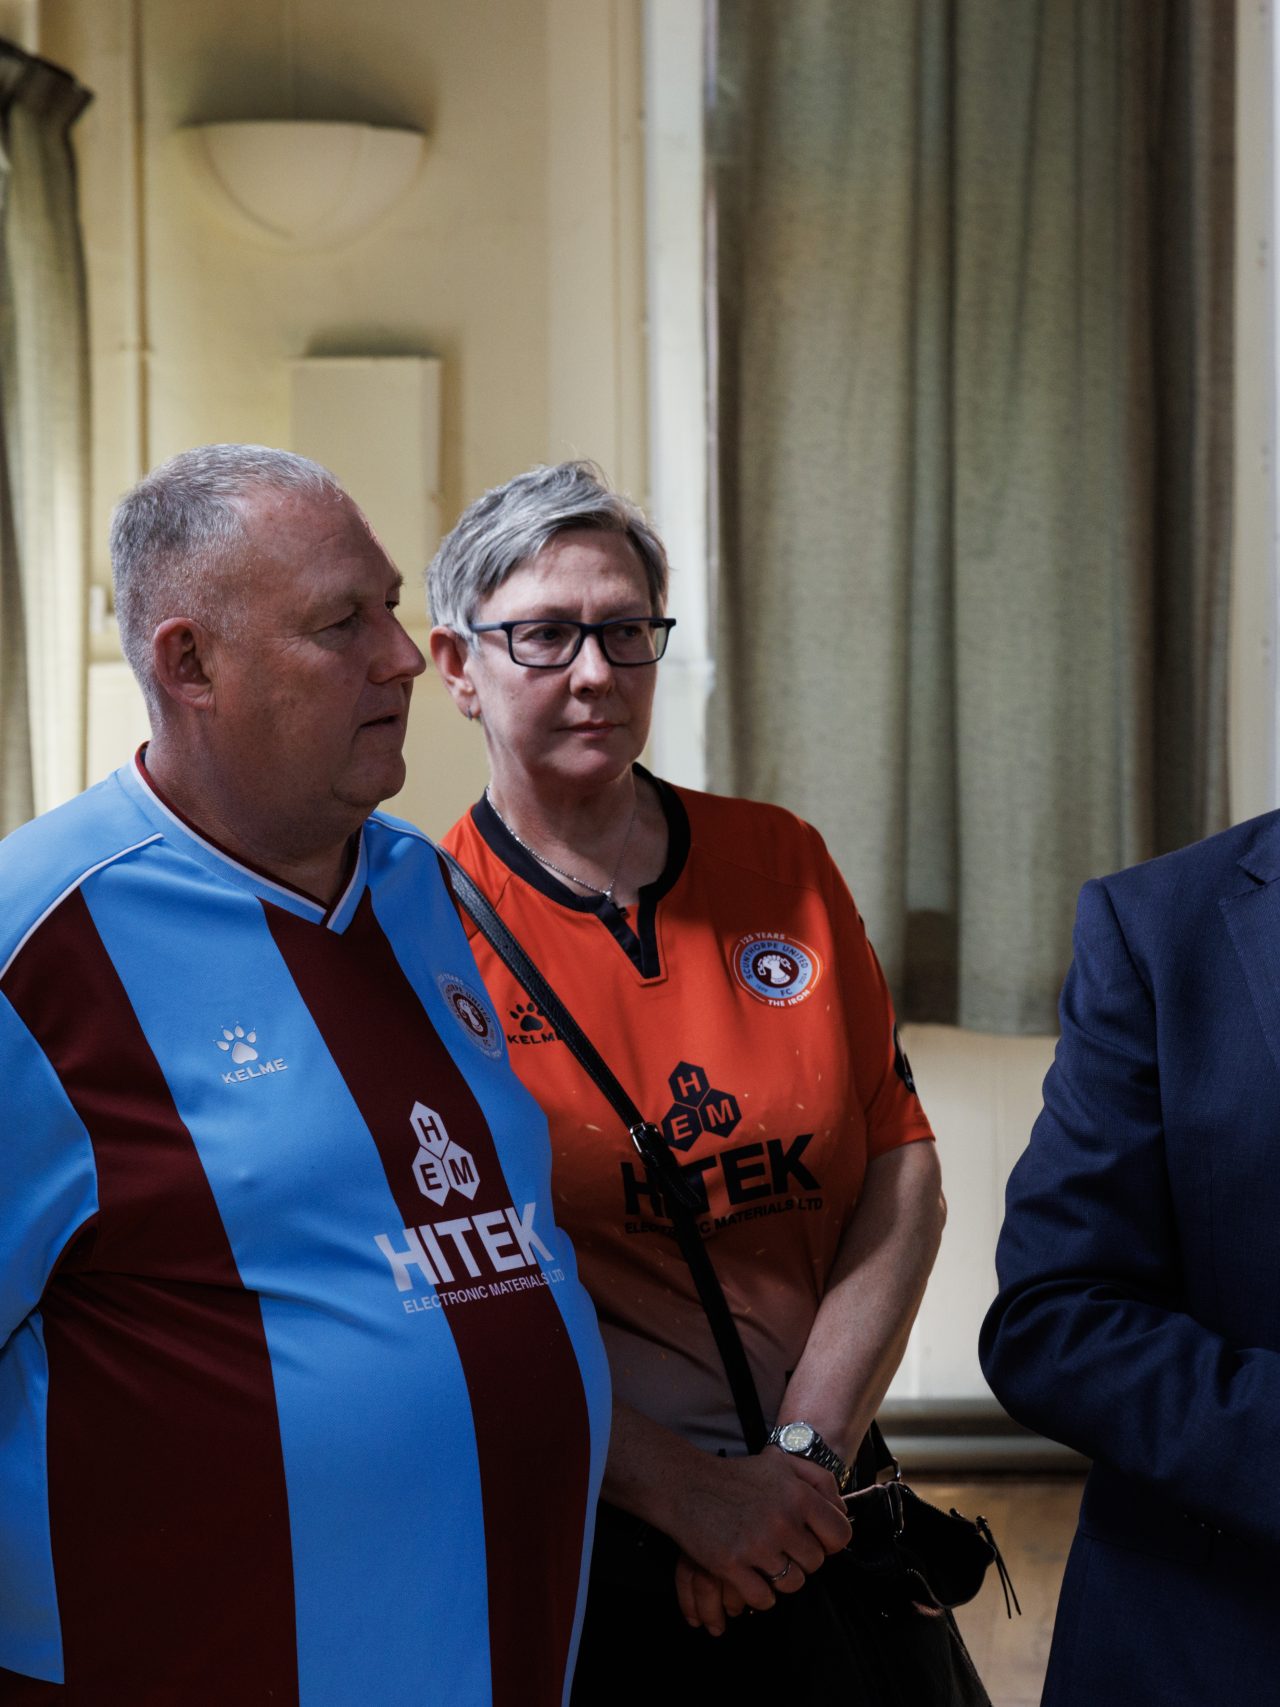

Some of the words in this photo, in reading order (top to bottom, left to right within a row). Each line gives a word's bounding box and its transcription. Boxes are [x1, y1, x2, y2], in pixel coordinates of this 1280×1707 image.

[755, 932, 785, 941] YEARS
[742, 942, 779, 980] SCUNTHORPE
[782, 945, 809, 969] UNITED
[768, 999, 785, 1007] THE
[788, 989, 811, 1006] IRON
[780, 988, 793, 997] FC
[507, 1032, 562, 1045] KELM
[221, 1058, 289, 1084] KELME
[677, 1072, 702, 1098] H
[417, 1115, 443, 1144] H
[671, 1114, 694, 1141] E
[706, 1099, 735, 1128] M
[420, 1162, 443, 1191] E
[449, 1156, 475, 1186] M
[620, 1133, 821, 1217] HTEK
[714, 1199, 794, 1231] MATERIALS
[797, 1197, 824, 1211] LTD
[373, 1202, 555, 1292] HITEK
[403, 1286, 489, 1314] ELECTRONIC
[488, 1271, 551, 1297] MATERIALS
[549, 1268, 566, 1284] LTD
